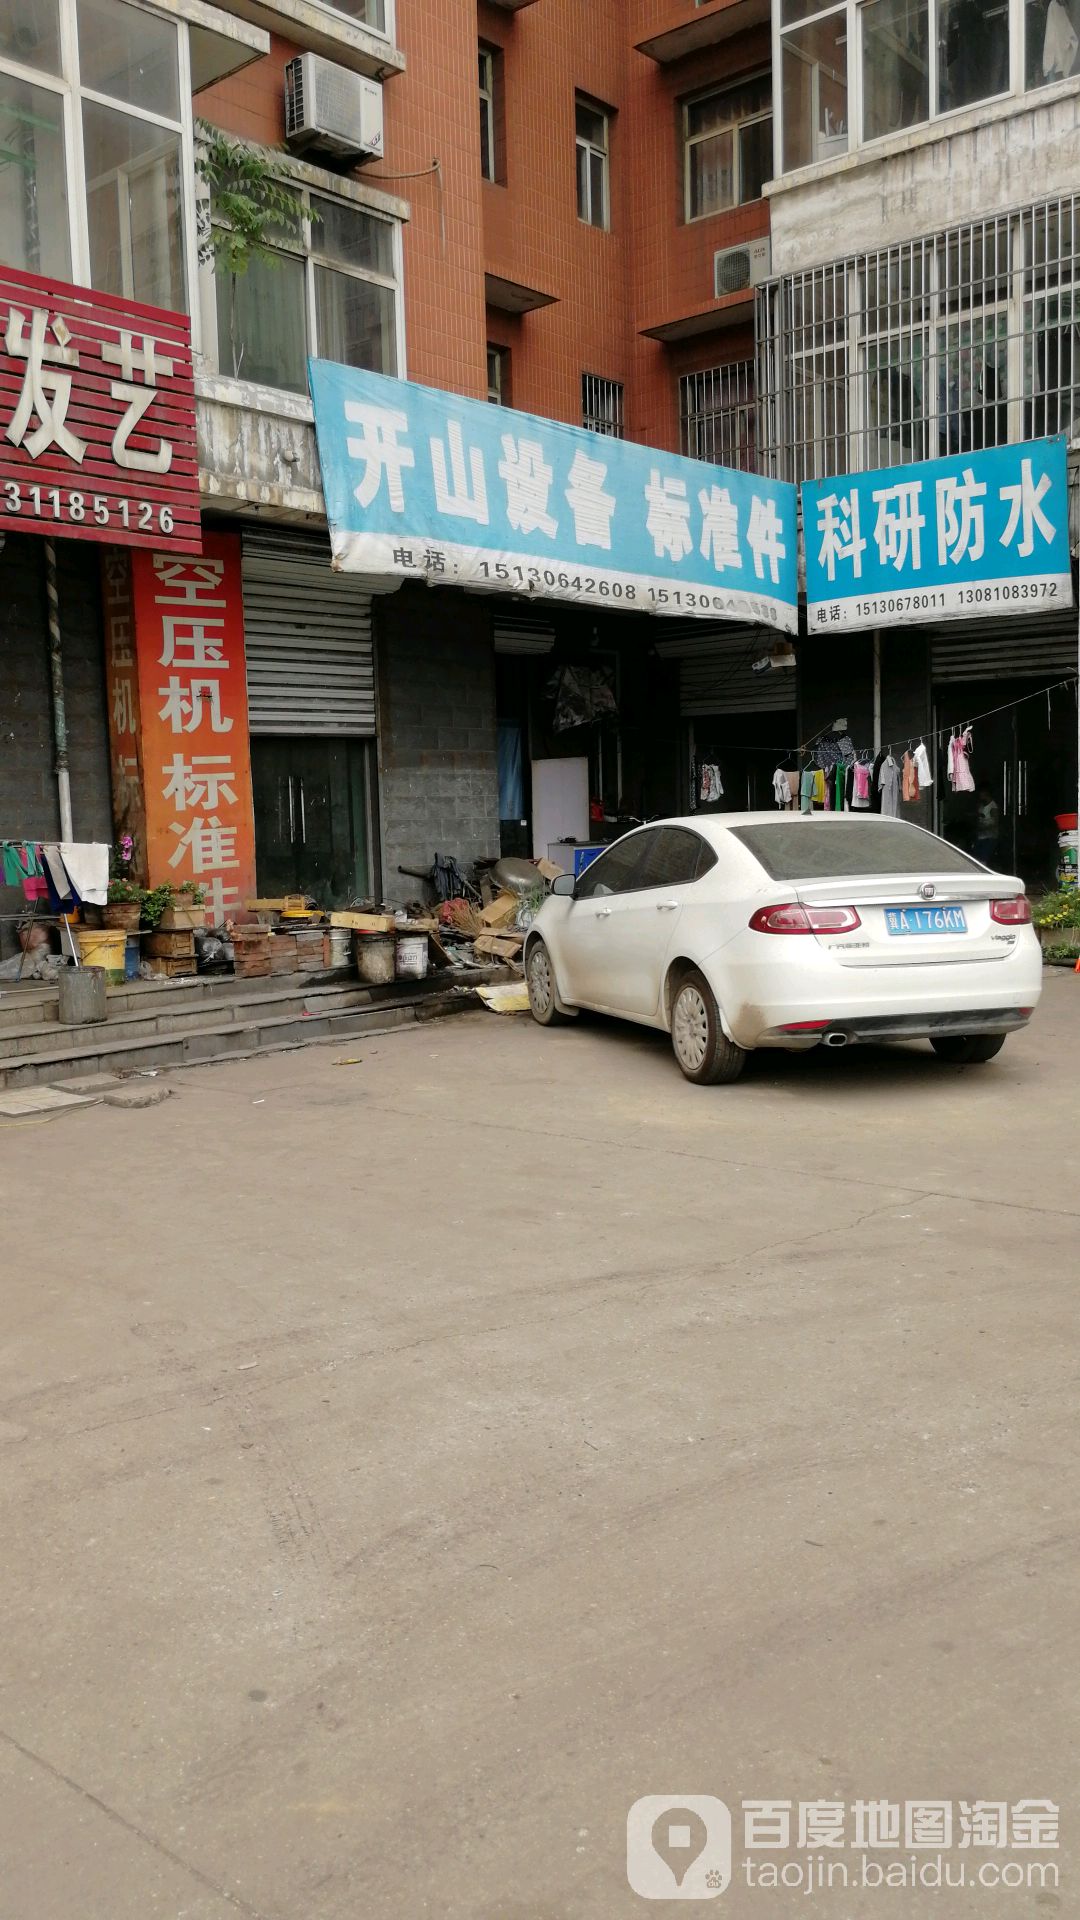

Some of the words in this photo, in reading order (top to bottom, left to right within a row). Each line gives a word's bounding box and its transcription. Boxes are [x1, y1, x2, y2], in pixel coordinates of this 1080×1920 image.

[5, 307, 173, 474] 发艺
[4, 482, 174, 534] 31185126
[343, 400, 617, 551] 开山设备
[644, 468, 786, 584] 标准件
[816, 458, 1057, 582] 科研防水
[479, 561, 636, 600] 15130642608
[855, 592, 946, 616] 15130678011
[957, 582, 1058, 604] 13081083972
